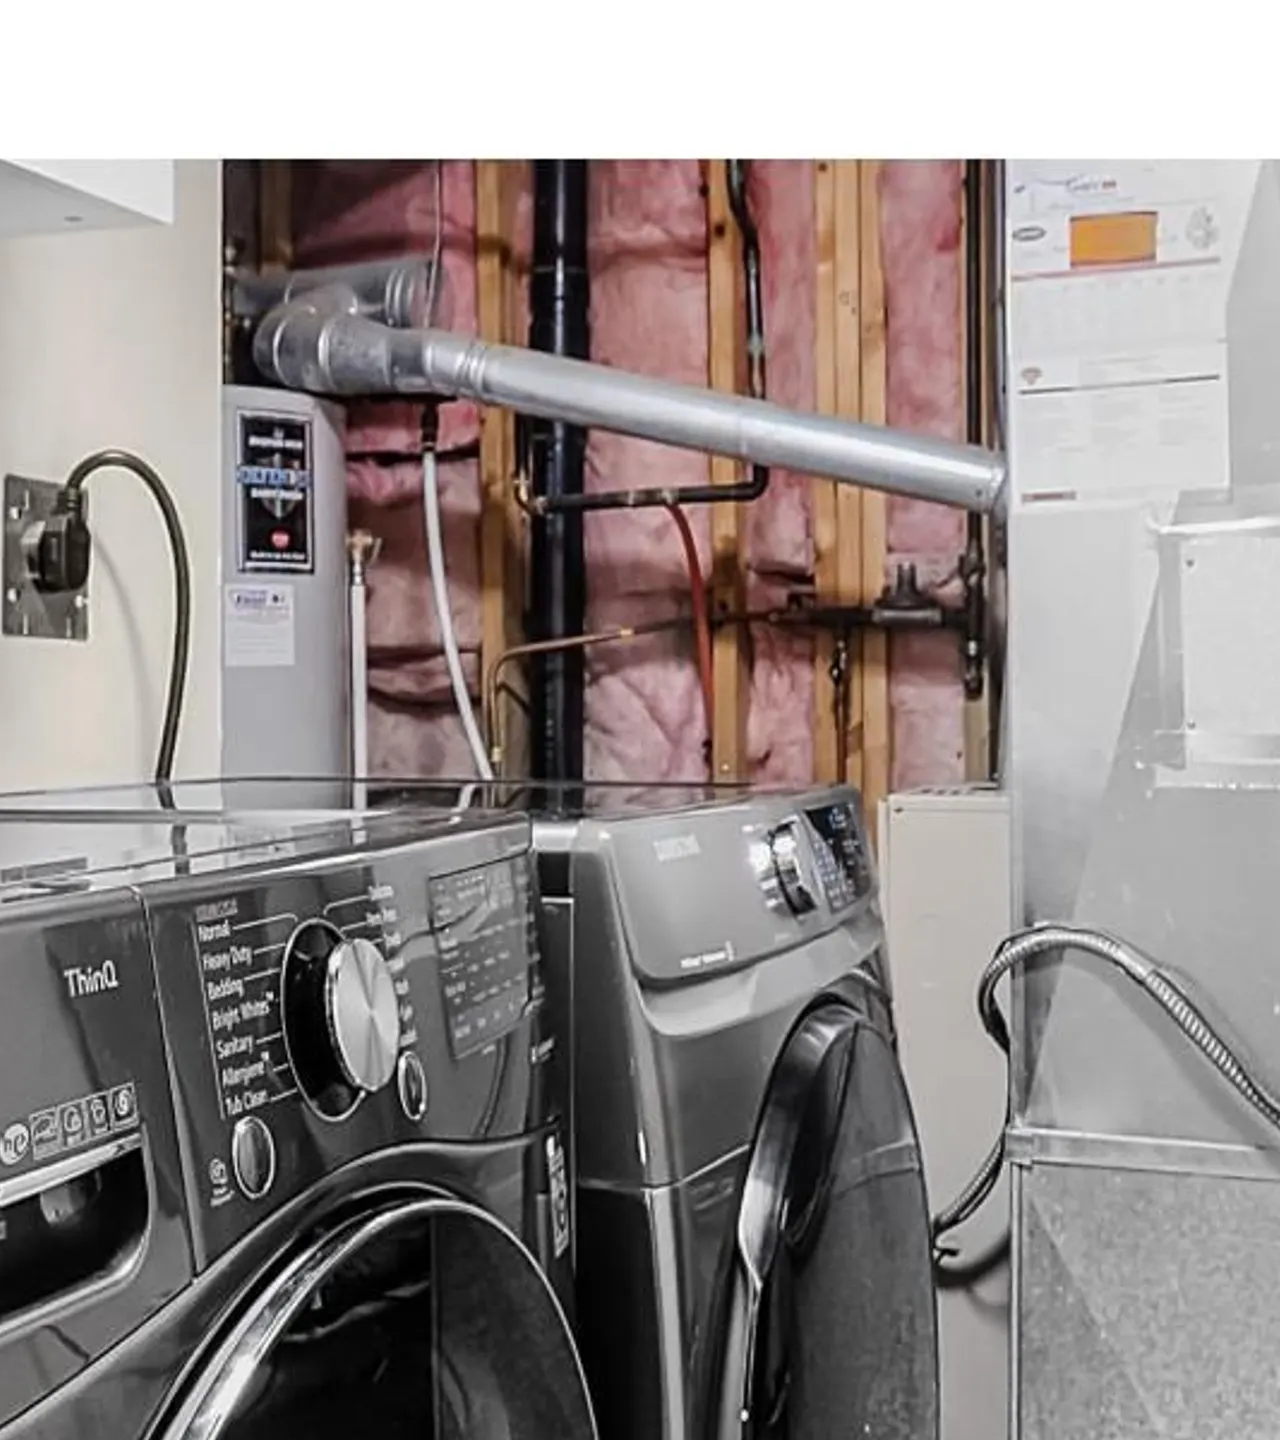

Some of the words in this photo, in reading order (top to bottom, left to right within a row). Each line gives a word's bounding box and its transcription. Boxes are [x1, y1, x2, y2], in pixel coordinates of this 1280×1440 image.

[199, 919, 230, 941] Normal
[64, 960, 119, 998] ThinQ
[208, 977, 244, 1000] Bedding
[217, 1035, 253, 1059] Sanitary
[225, 1095, 243, 1117] Tub
